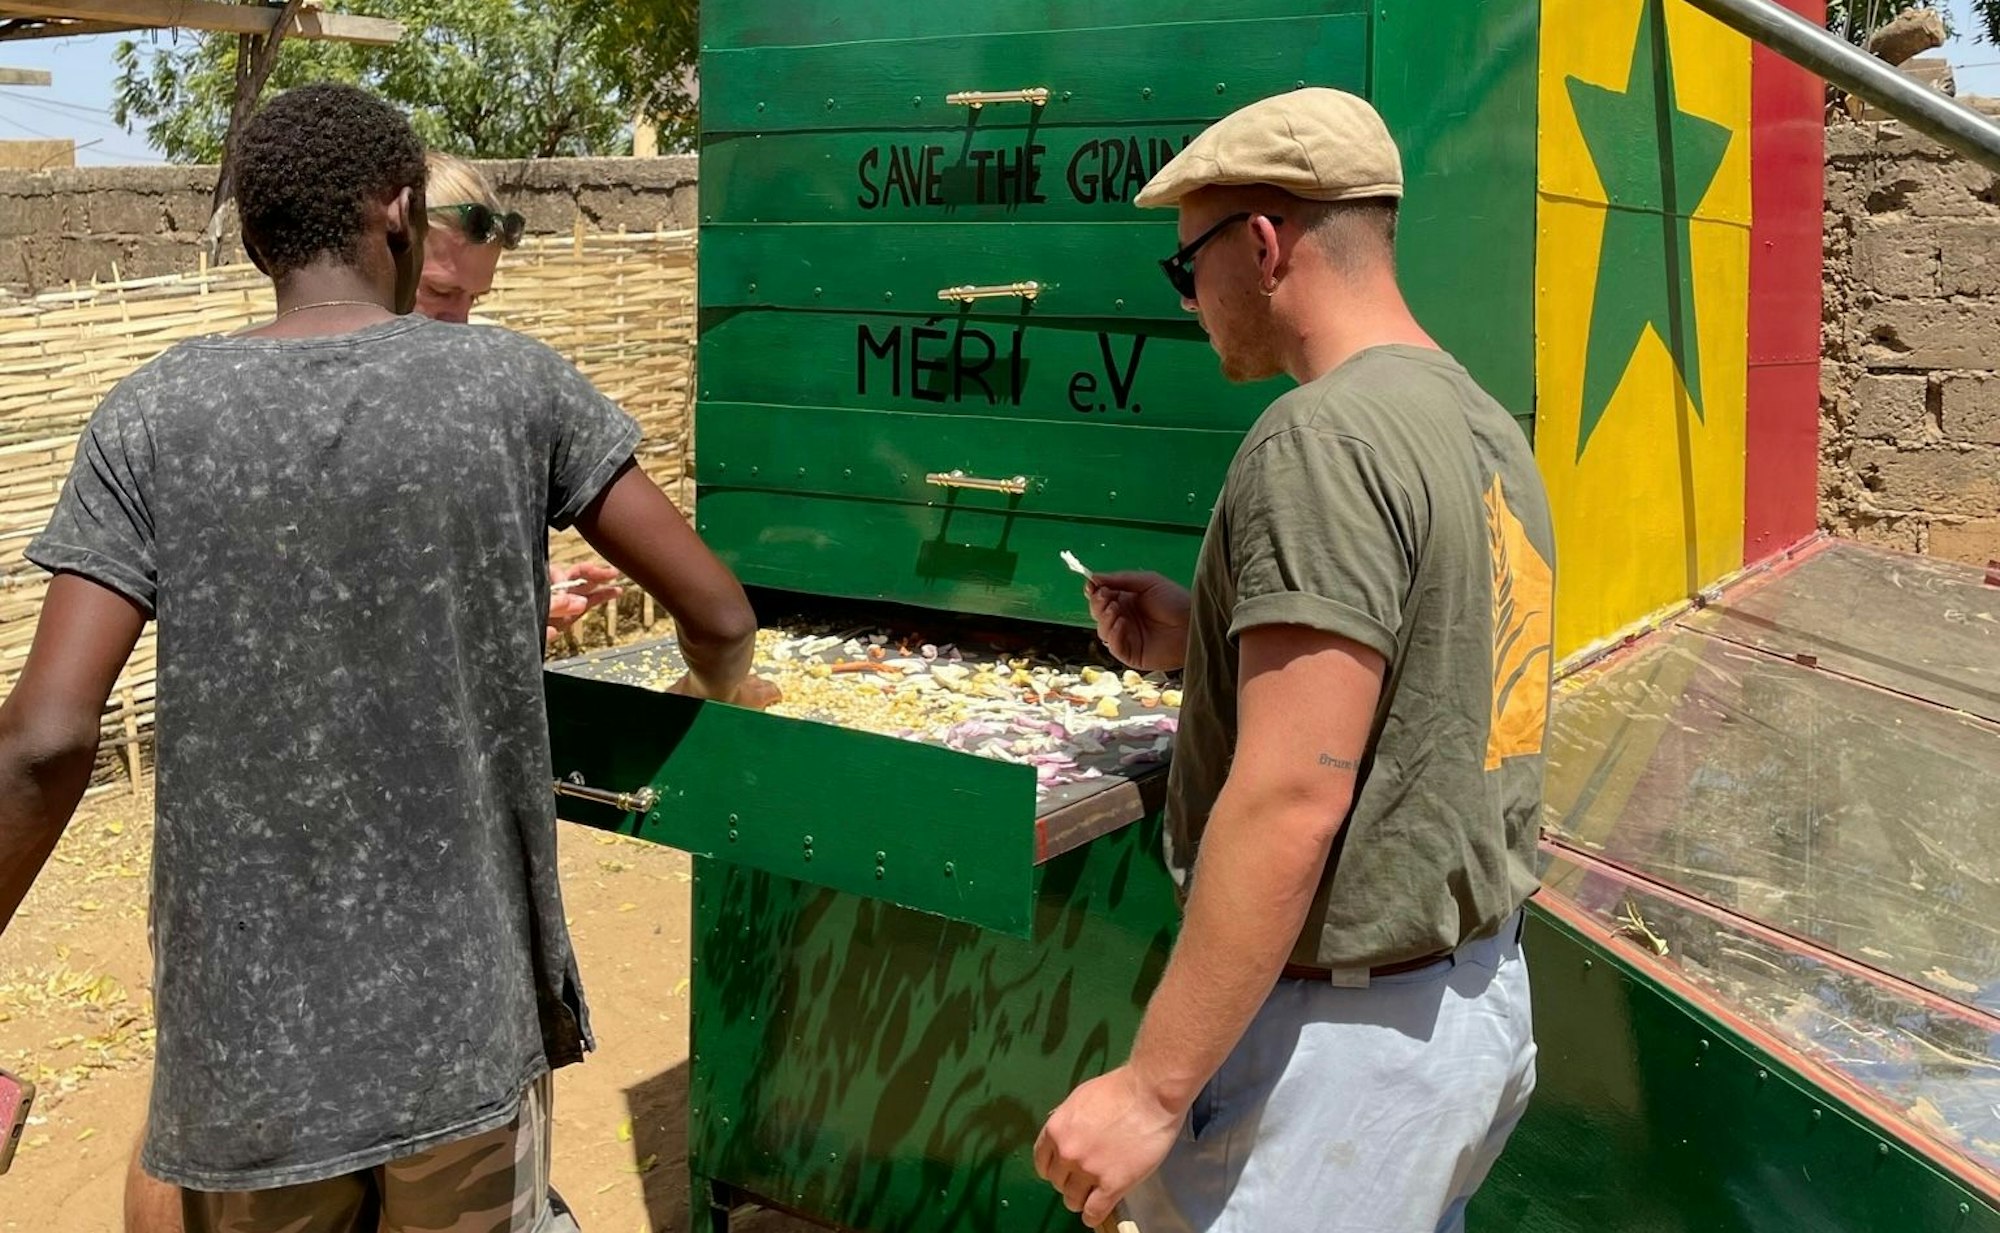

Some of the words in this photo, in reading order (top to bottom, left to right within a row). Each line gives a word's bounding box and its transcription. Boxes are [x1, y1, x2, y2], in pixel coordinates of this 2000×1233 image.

[857, 144, 945, 209] SAVE
[969, 145, 1046, 204] THE
[857, 316, 1020, 406] MÉRI
[1068, 332, 1147, 413] e.V.
